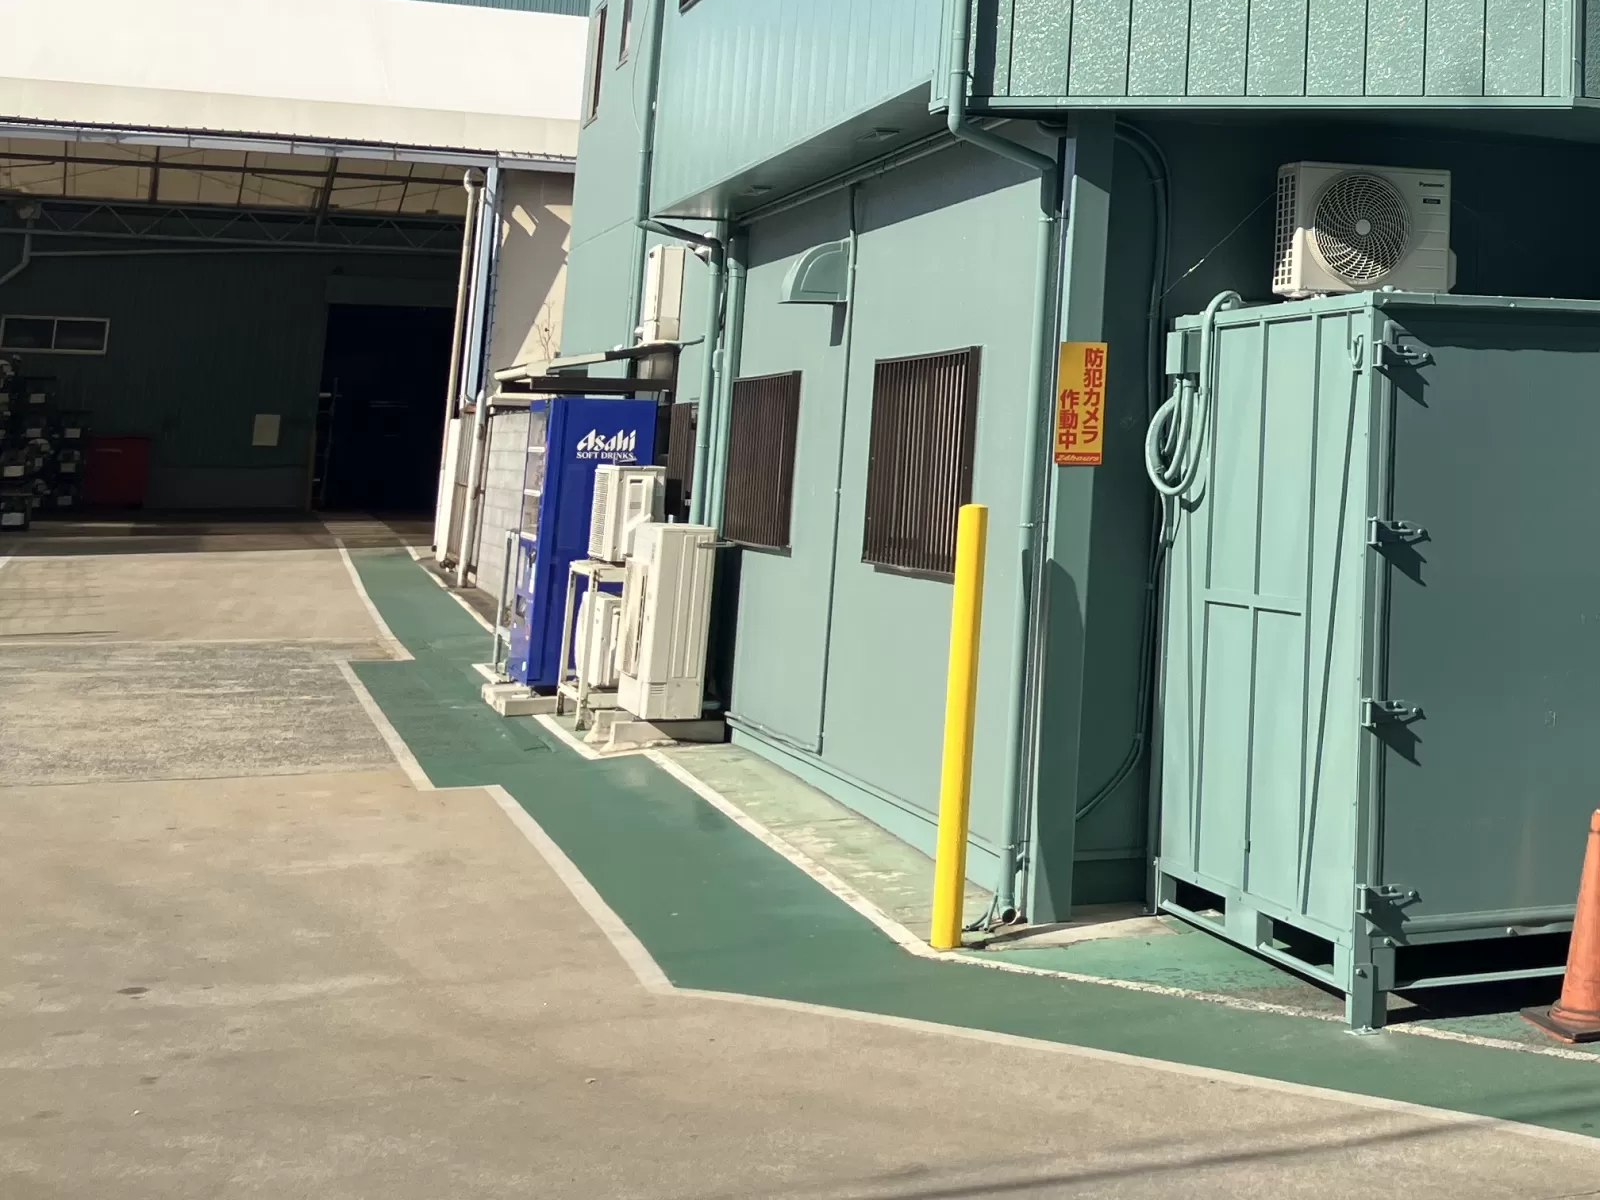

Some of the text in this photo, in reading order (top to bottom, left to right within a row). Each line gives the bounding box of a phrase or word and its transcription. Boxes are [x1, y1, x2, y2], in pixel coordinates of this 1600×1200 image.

[1058, 389, 1080, 450] 作動中
[1081, 347, 1104, 444] 防犯カメラ
[577, 428, 636, 451] Asahi
